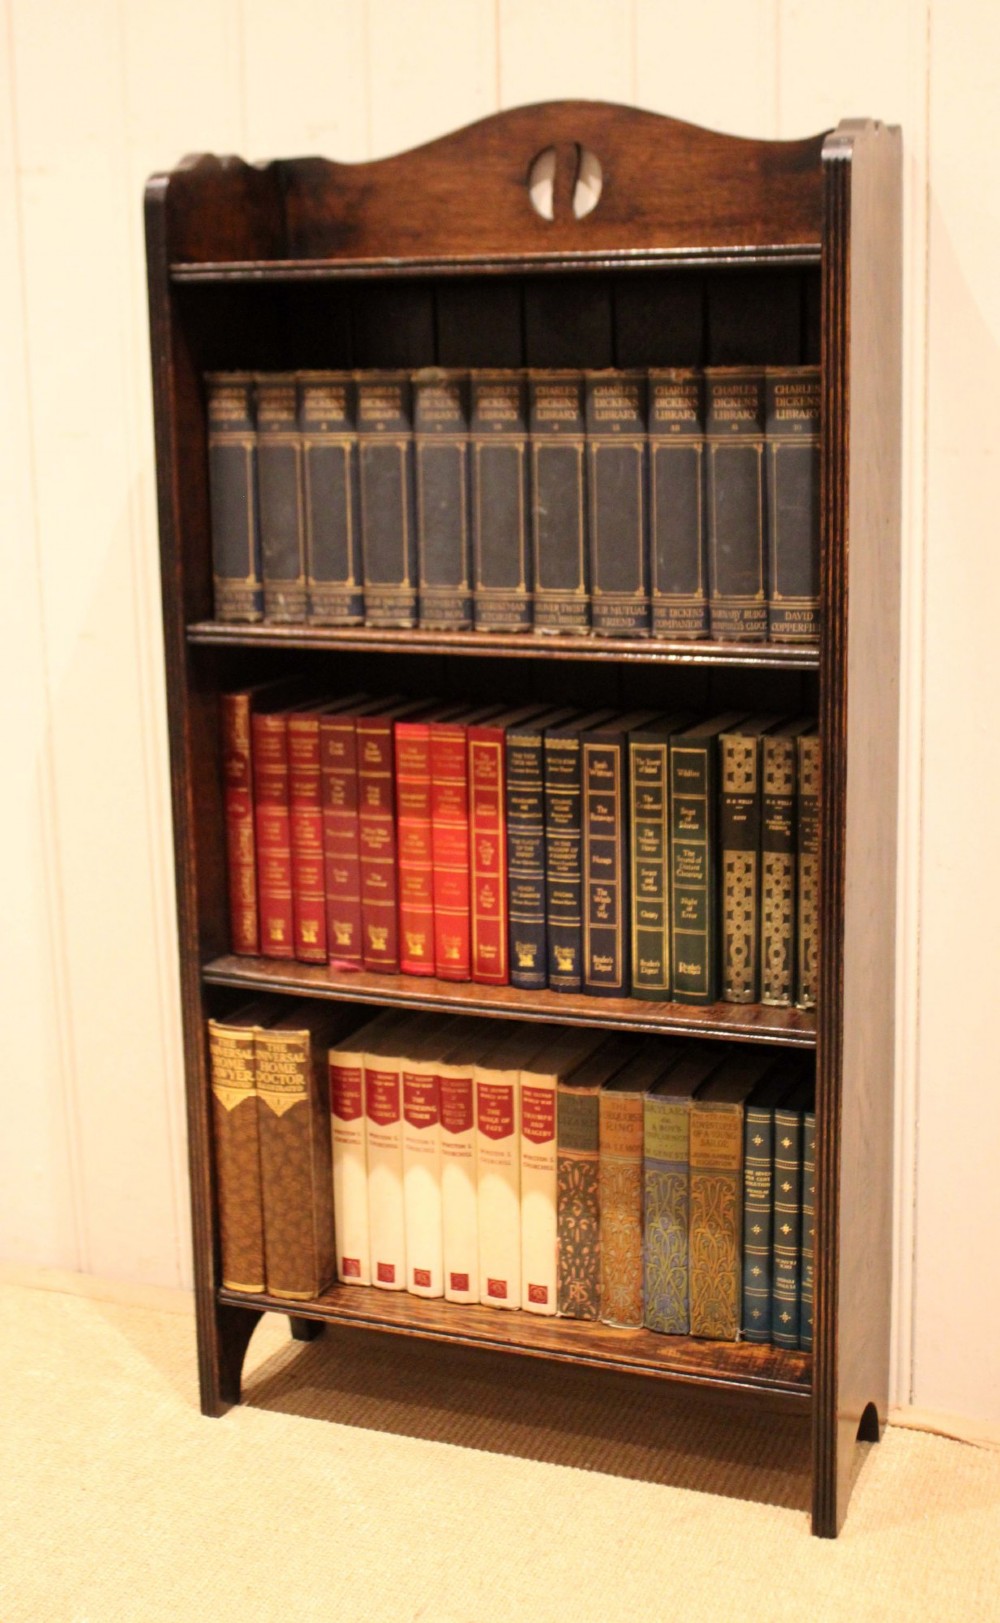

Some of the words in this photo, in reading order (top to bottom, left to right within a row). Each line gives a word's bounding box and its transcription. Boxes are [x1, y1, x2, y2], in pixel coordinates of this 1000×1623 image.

[593, 385, 638, 396] CHARLES
[655, 385, 698, 395] CHARLES
[713, 385, 757, 395] CHARLES
[774, 384, 820, 395] CHARLES
[594, 398, 638, 408] DICKENS
[655, 397, 698, 408] DICKENS
[713, 397, 757, 407] DICKENS
[775, 396, 820, 407] DICKENS
[595, 410, 637, 420] LIBRARY
[655, 409, 697, 420] LIBRARY
[714, 409, 757, 420] LIBRARY
[775, 408, 820, 420] LIBRARY
[611, 605, 647, 615] MUTUAL
[669, 608, 704, 618] DICKENS
[784, 611, 814, 621] DAVID
[601, 617, 636, 627] FRIEND
[655, 619, 703, 629] COMPANION
[218, 1039, 237, 1049] THE
[267, 1043, 288, 1053] THE
[256, 1049, 306, 1063] UNIVERSAL
[260, 1060, 297, 1074] HOME
[256, 1070, 306, 1085] DOCTOR
[532, 1091, 553, 1099] SECOND
[487, 1108, 500, 1116] THE
[523, 1111, 553, 1121] TRIUMPH
[485, 1124, 503, 1132] FATE
[530, 1121, 545, 1129] AND
[607, 1121, 634, 1133] RING
[523, 1127, 552, 1137] TRAGEDY
